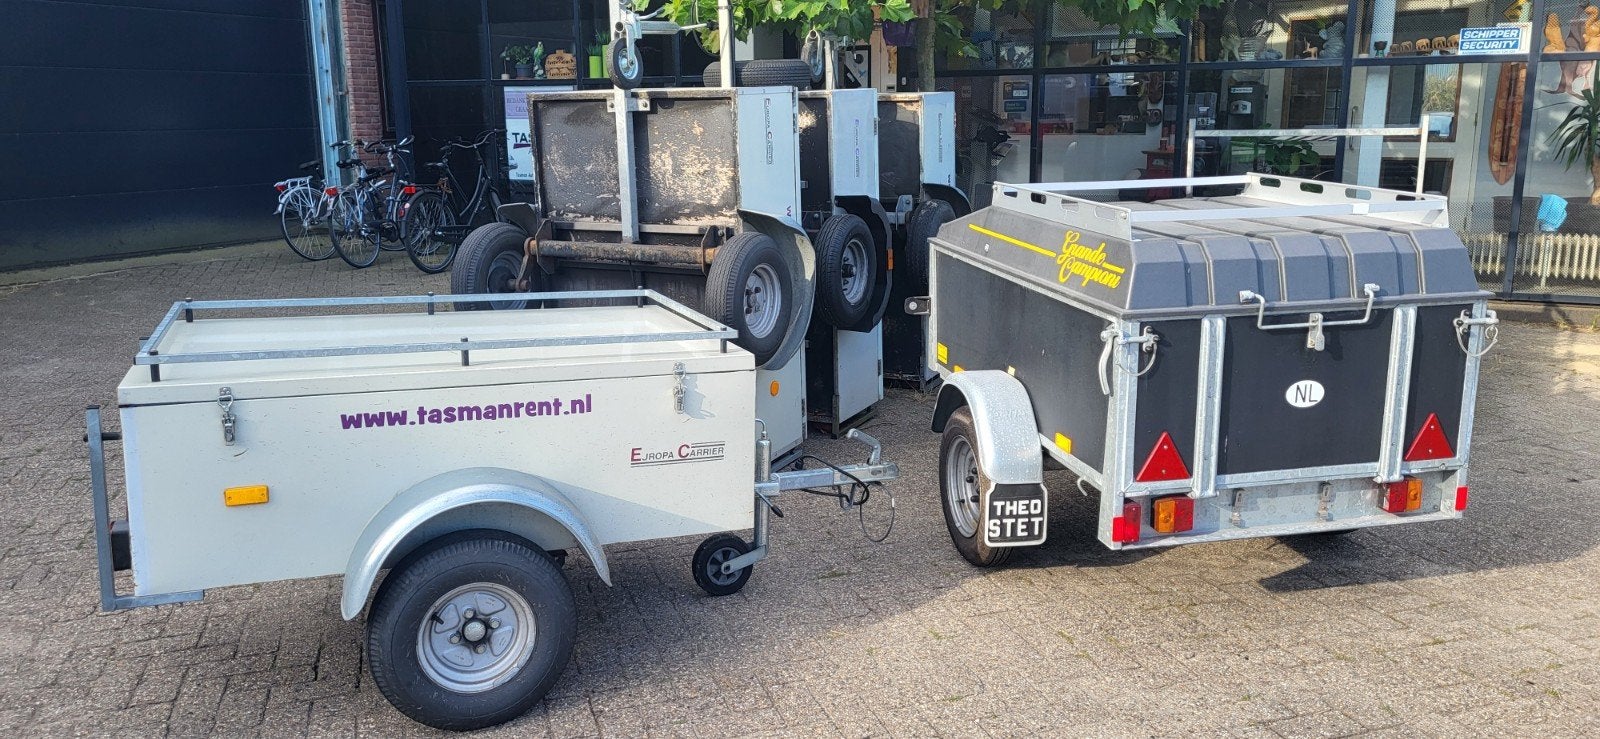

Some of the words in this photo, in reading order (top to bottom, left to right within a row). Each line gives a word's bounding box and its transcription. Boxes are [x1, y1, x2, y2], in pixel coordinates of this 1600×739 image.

[1463, 29, 1519, 39] SCHIPPER
[1461, 40, 1517, 50] SECURITY
[1057, 230, 1107, 265] Grande
[1295, 383, 1319, 403] NL
[340, 393, 592, 429] www.tasmanrent.nl
[677, 443, 725, 459] CARRIER
[993, 499, 1042, 516] THEO
[988, 517, 1043, 538] STET
